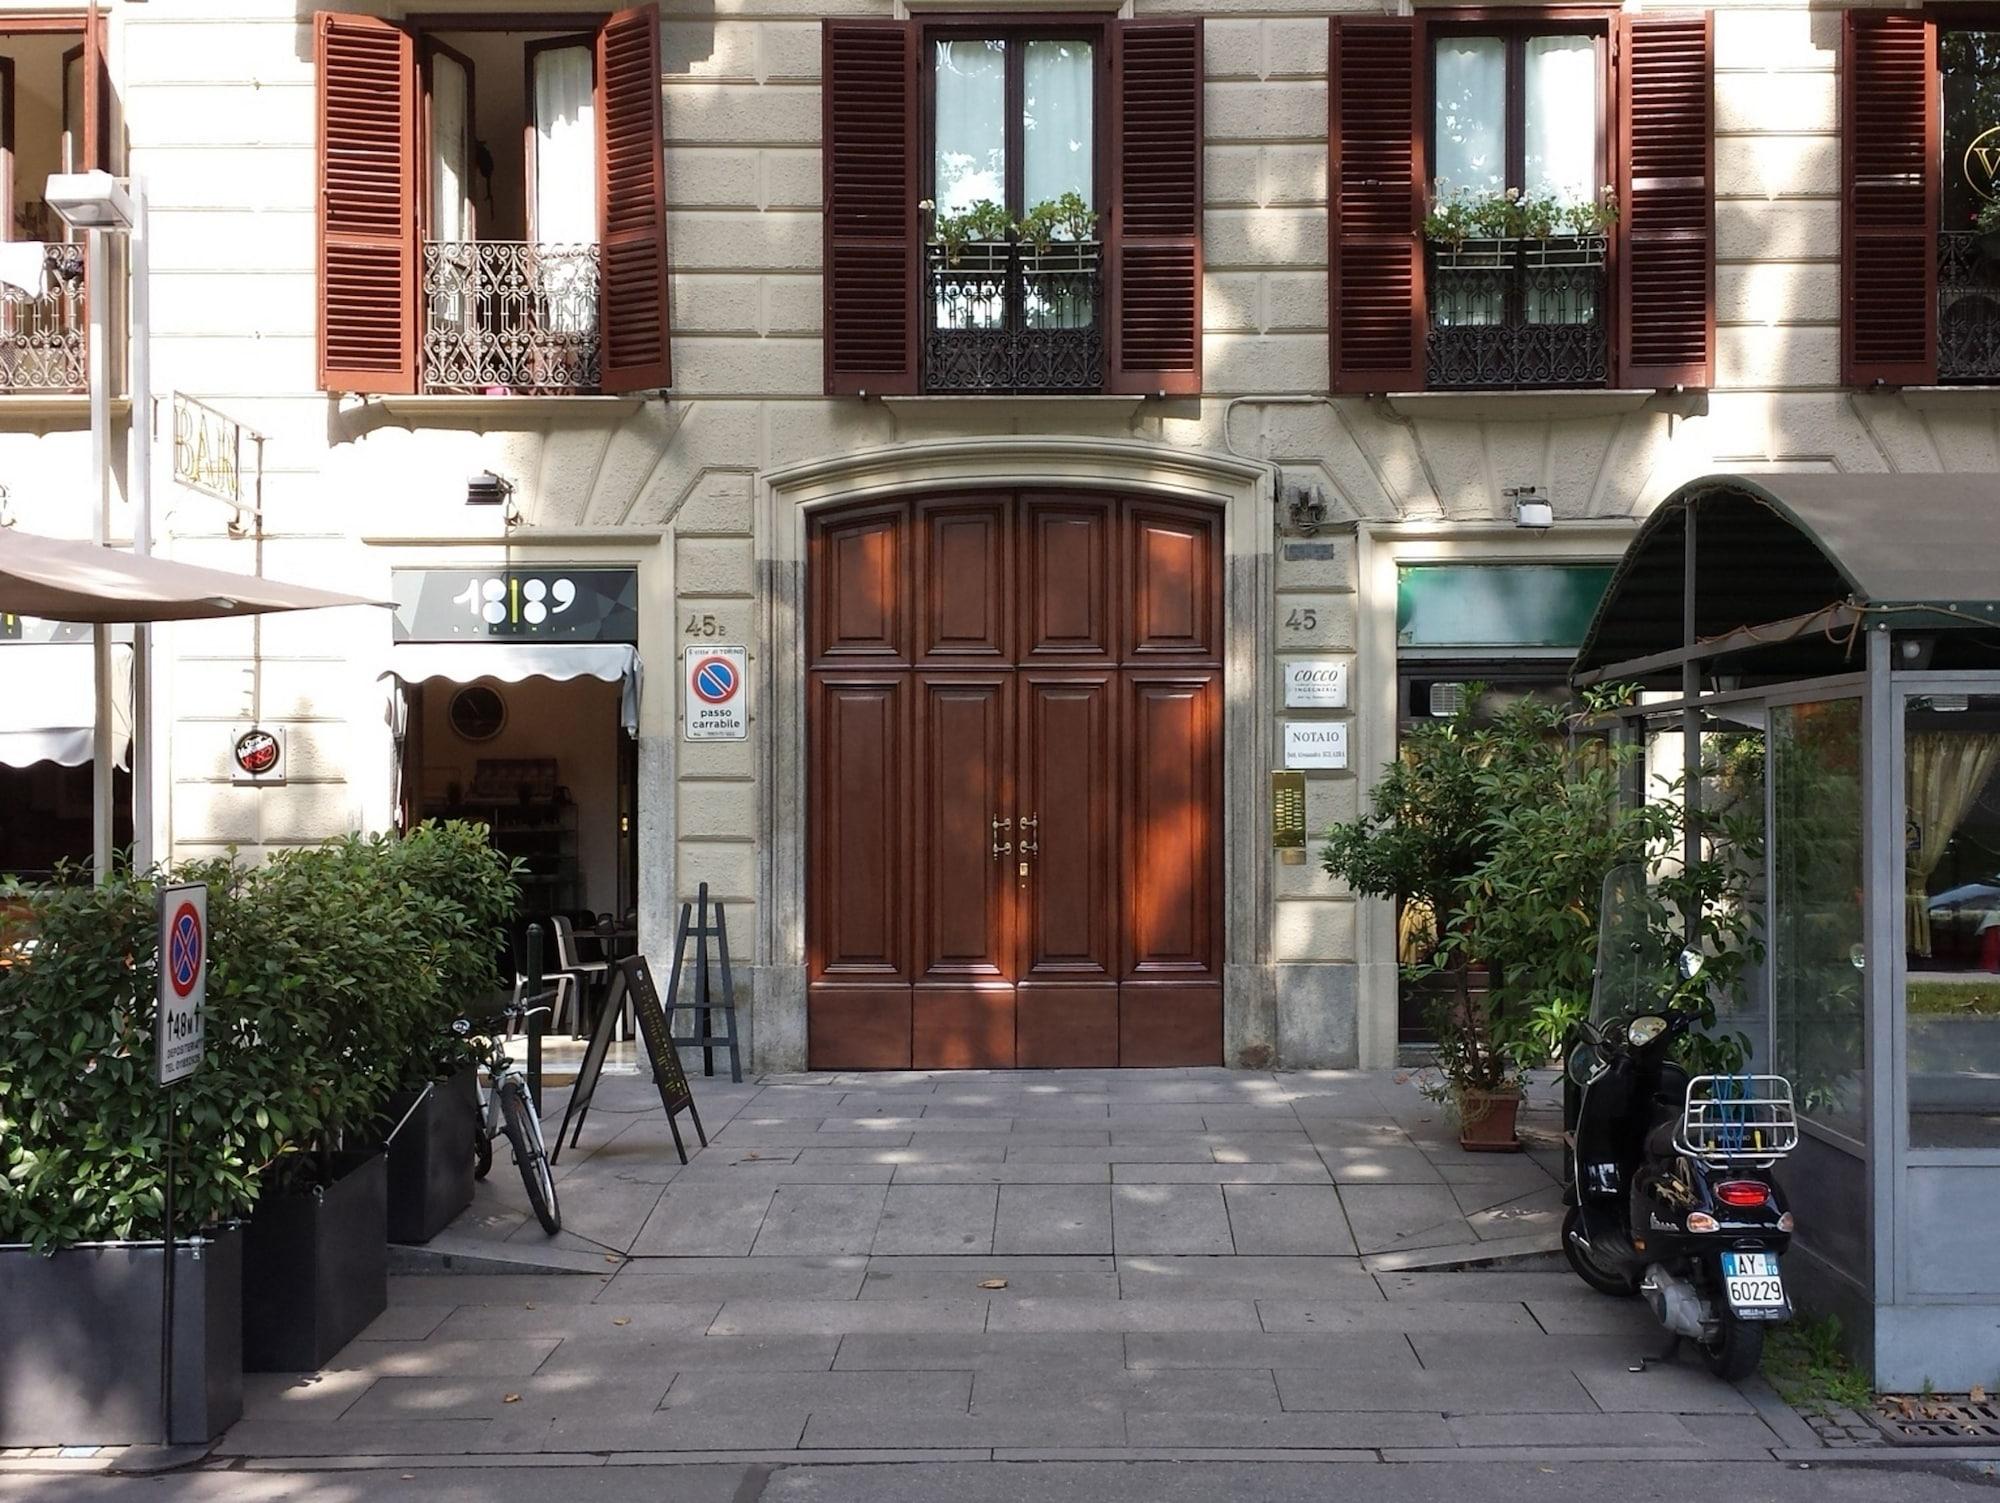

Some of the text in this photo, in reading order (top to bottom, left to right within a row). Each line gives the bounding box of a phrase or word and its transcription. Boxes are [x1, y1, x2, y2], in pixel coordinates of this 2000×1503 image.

[174, 404, 240, 497] BAR
[1285, 608, 1317, 631] 45
[1294, 670, 1338, 682] COCCO
[692, 718, 741, 729] carrabile
[700, 709, 732, 718] passo
[1293, 731, 1340, 742] NOTAIO
[174, 1011, 187, 1040] 48
[1739, 1255, 1756, 1275] AY
[1767, 1265, 1779, 1275] TO
[1730, 1280, 1782, 1301] 60229
